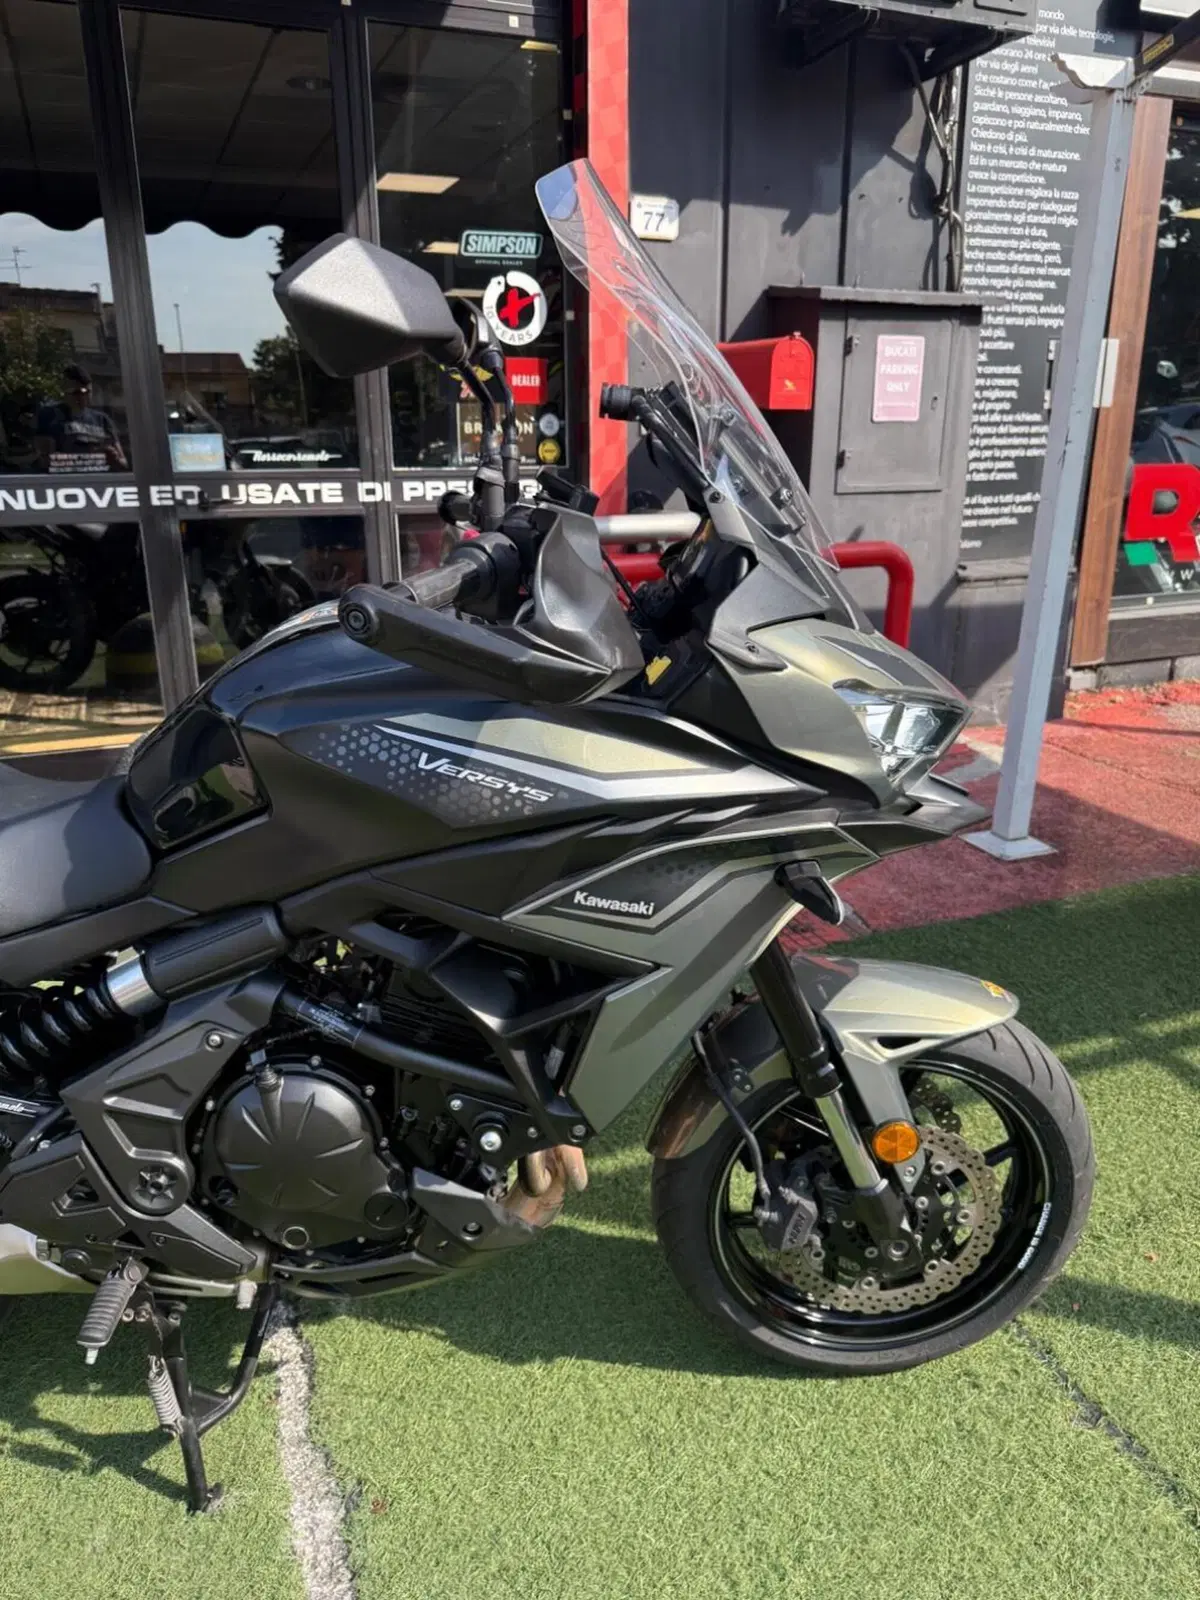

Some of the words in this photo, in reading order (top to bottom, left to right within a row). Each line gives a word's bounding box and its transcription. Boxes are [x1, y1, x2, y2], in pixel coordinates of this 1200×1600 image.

[1038, 10, 1065, 20] mondo
[1036, 23, 1048, 34] per
[1050, 24, 1060, 34] via
[1061, 26, 1078, 37] delle
[1024, 49, 1033, 59] 24
[1034, 53, 1046, 62] ore
[976, 57, 989, 69] Per
[989, 59, 1000, 70] via
[1001, 61, 1020, 74] degli
[1020, 65, 1038, 74] aerei
[976, 72, 989, 83] che
[989, 76, 1017, 86] costano
[1018, 79, 1037, 88] come
[974, 85, 997, 98] Sicché
[997, 88, 1004, 98] le
[1005, 92, 1034, 102] persone
[1034, 94, 1068, 107] ascoltano,
[973, 101, 1010, 114] guardano,
[1011, 106, 1047, 118] viaggiano,
[1048, 109, 1083, 121] imparano,
[972, 115, 1007, 126] capiscono
[1007, 120, 1013, 128] e
[1014, 119, 1026, 129] poi
[1026, 122, 1073, 133] naturalmente
[971, 128, 1006, 140] Chiedono
[1006, 132, 1014, 141] di
[1014, 133, 1029, 143] più.
[970, 141, 986, 153] Non
[992, 144, 1008, 155] crisi,
[1014, 146, 1028, 156] crisi
[1028, 147, 1037, 157] di
[1037, 150, 1082, 160] maturazione.
[969, 155, 979, 166] Ed
[980, 156, 987, 166] in
[988, 159, 998, 167] un
[999, 160, 1028, 169] mercato
[1029, 161, 1041, 170] che
[1042, 164, 1068, 172] matura
[968, 169, 990, 180] cresce
[990, 170, 997, 181] la
[998, 174, 1046, 184] competizione.
[967, 182, 976, 193] La
[976, 186, 1024, 196] competizione
[1024, 188, 1053, 199] migliora
[1054, 189, 1060, 199] la
[1061, 192, 1080, 200] razza
[966, 195, 1008, 208] imponendo
[1008, 199, 1026, 209] sforzi
[1027, 202, 1040, 211] per
[1040, 202, 1077, 214] riadeguarsi
[644, 211, 665, 231] 77
[965, 210, 1012, 221] giornalmente
[1013, 213, 1026, 224] agli
[1026, 215, 1057, 224] standard
[964, 222, 972, 233] La
[973, 224, 1009, 234] situazione
[1010, 227, 1024, 235] non
[1030, 227, 1048, 238] dura,
[466, 234, 537, 255] SIMPSON
[969, 238, 1019, 248] estremamente
[1019, 240, 1031, 250] più
[1032, 241, 1062, 252] esigente.
[985, 251, 1007, 260] molto
[1007, 252, 1043, 263] divertente,
[1044, 254, 1062, 264] però,
[974, 263, 985, 272] chi
[986, 265, 1010, 274] accetta
[1011, 265, 1018, 274] di
[1018, 266, 1035, 275] stare
[1036, 266, 1047, 275] nel
[1048, 268, 1071, 276] mercat
[990, 278, 1012, 289] regole
[1012, 278, 1024, 289] più
[1025, 280, 1058, 289] moderne.
[1020, 292, 1044, 301] poteva
[1012, 304, 1038, 314] impresa,
[987, 314, 1004, 325] frutti
[1005, 317, 1024, 325] senza
[1025, 316, 1036, 327] più
[495, 323, 533, 342] YEARS
[993, 328, 1007, 339] più.
[884, 346, 917, 357] DUCATI
[880, 364, 919, 376] PARKING
[512, 375, 541, 387] DEALER
[886, 382, 910, 392] ONLY
[985, 402, 1011, 412] proprio
[980, 412, 989, 422] ed
[1002, 414, 1013, 422] sue
[997, 425, 1008, 434] del
[980, 437, 1029, 447] professionismo
[981, 450, 993, 459] per
[994, 448, 1000, 457] la
[1000, 449, 1026, 458] propria
[969, 461, 994, 471] proprio
[972, 472, 989, 481] fatto
[0, 486, 140, 512] NUOVE
[150, 484, 201, 506] ED
[222, 482, 344, 504] USATE
[357, 482, 392, 502] DI
[999, 494, 1014, 503] tutti
[1014, 493, 1032, 504] quelli
[972, 507, 1000, 516] credono
[1000, 506, 1012, 514] nel
[1012, 505, 1034, 514] futuro
[418, 752, 553, 802] VERSYS
[573, 890, 655, 916] Kawasaki
